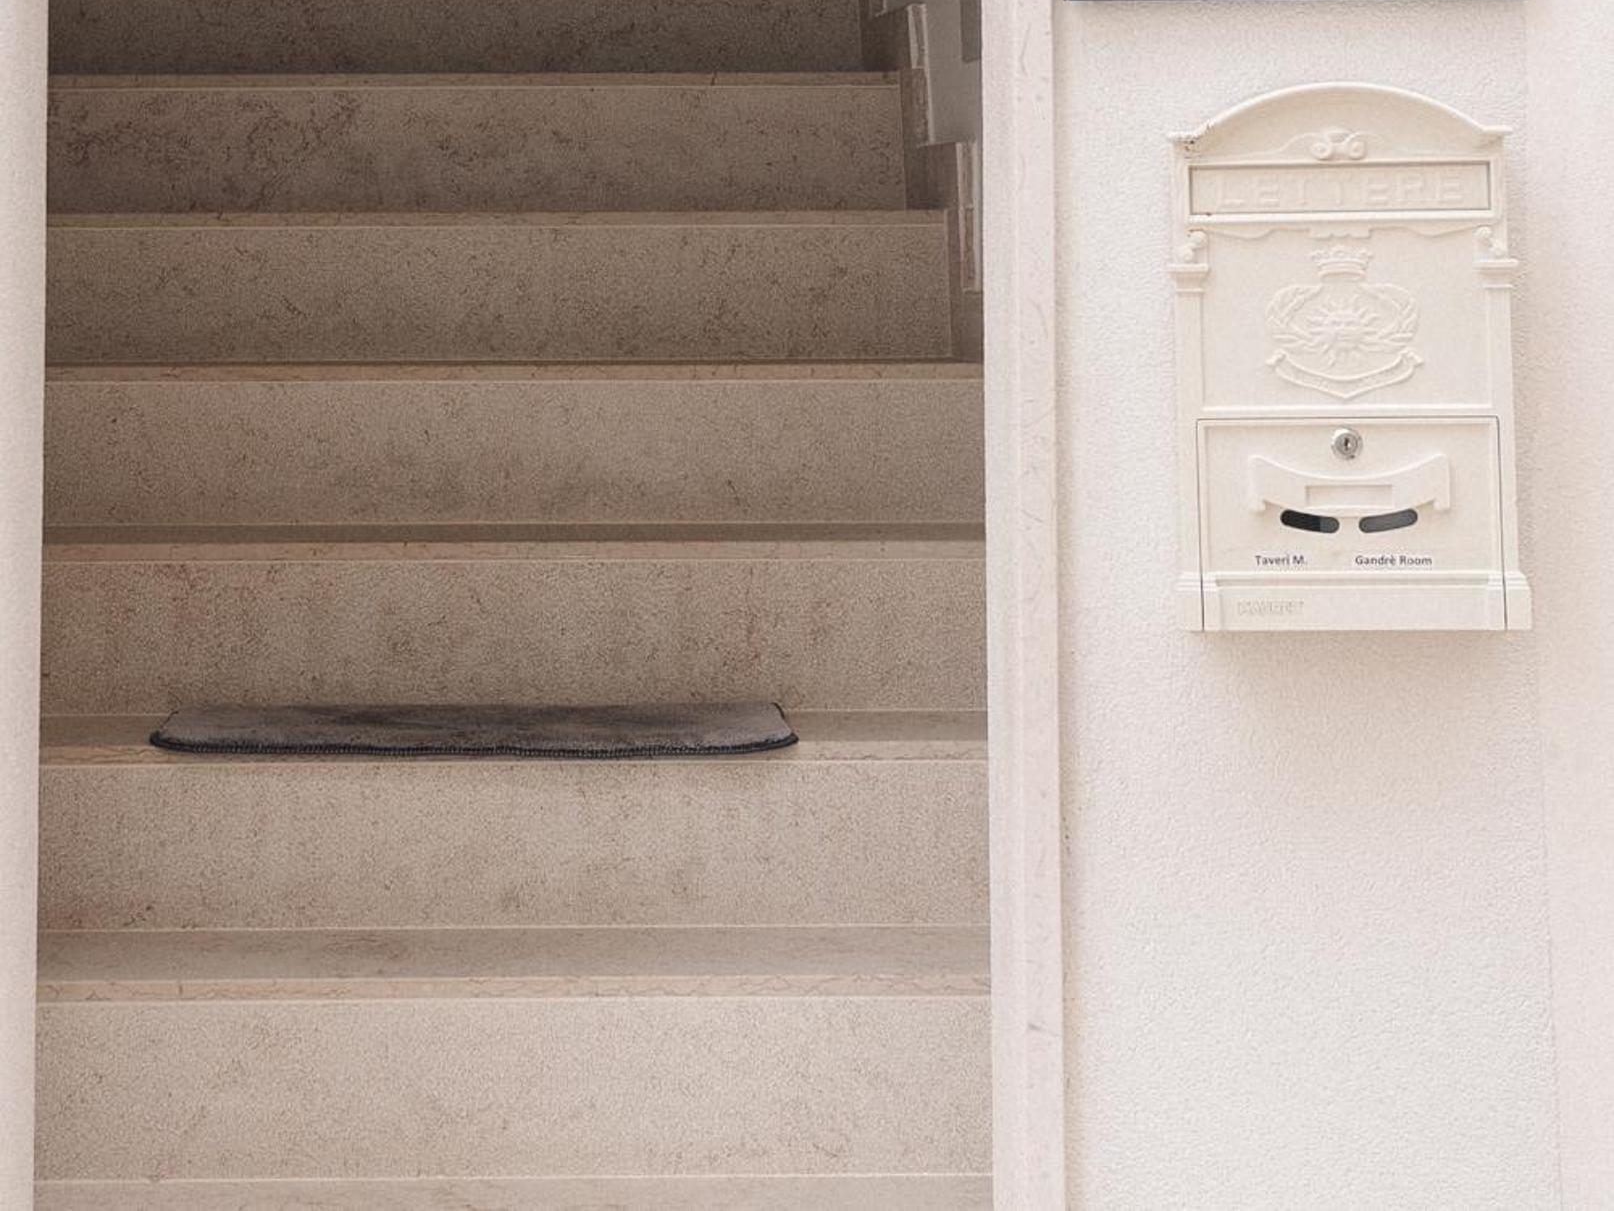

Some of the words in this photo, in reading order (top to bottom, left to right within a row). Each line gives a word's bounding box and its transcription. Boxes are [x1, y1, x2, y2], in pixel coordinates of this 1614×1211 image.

[1215, 171, 1466, 209] LETTERE
[1254, 554, 1291, 567] Taveri
[1293, 554, 1309, 566] M.
[1355, 554, 1397, 567] Gandrè
[1399, 554, 1433, 566] Room
